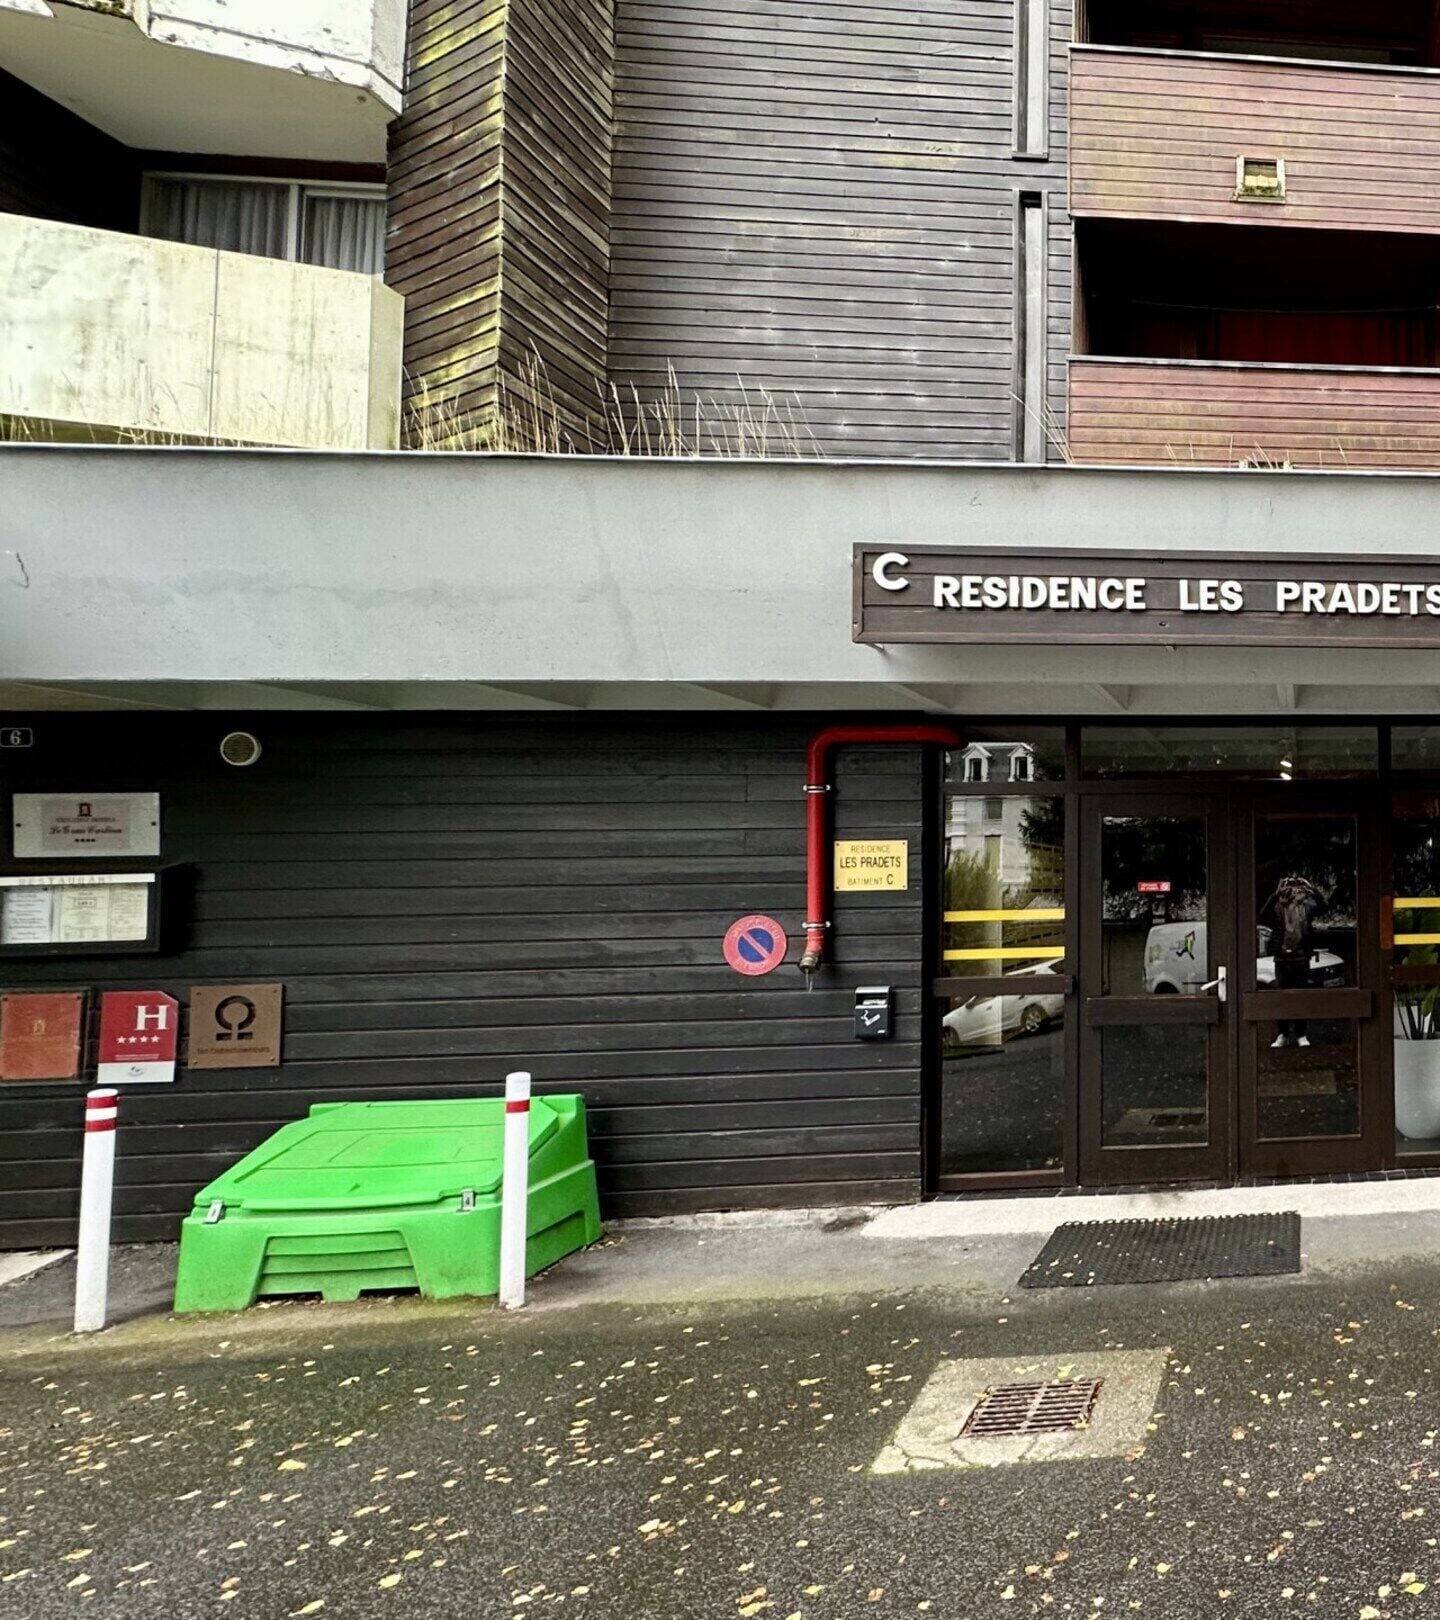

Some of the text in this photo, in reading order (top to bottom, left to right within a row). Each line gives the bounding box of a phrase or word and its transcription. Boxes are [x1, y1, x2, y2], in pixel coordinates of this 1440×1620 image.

[873, 553, 908, 589] C
[934, 576, 1145, 609] RESIDENCE
[1180, 580, 1242, 611] LES
[10, 729, 21, 745] 6
[851, 845, 890, 853] RESIDENCE
[840, 856, 901, 868] LES PRADETS
[886, 873, 894, 885] C
[136, 1004, 169, 1030] H
